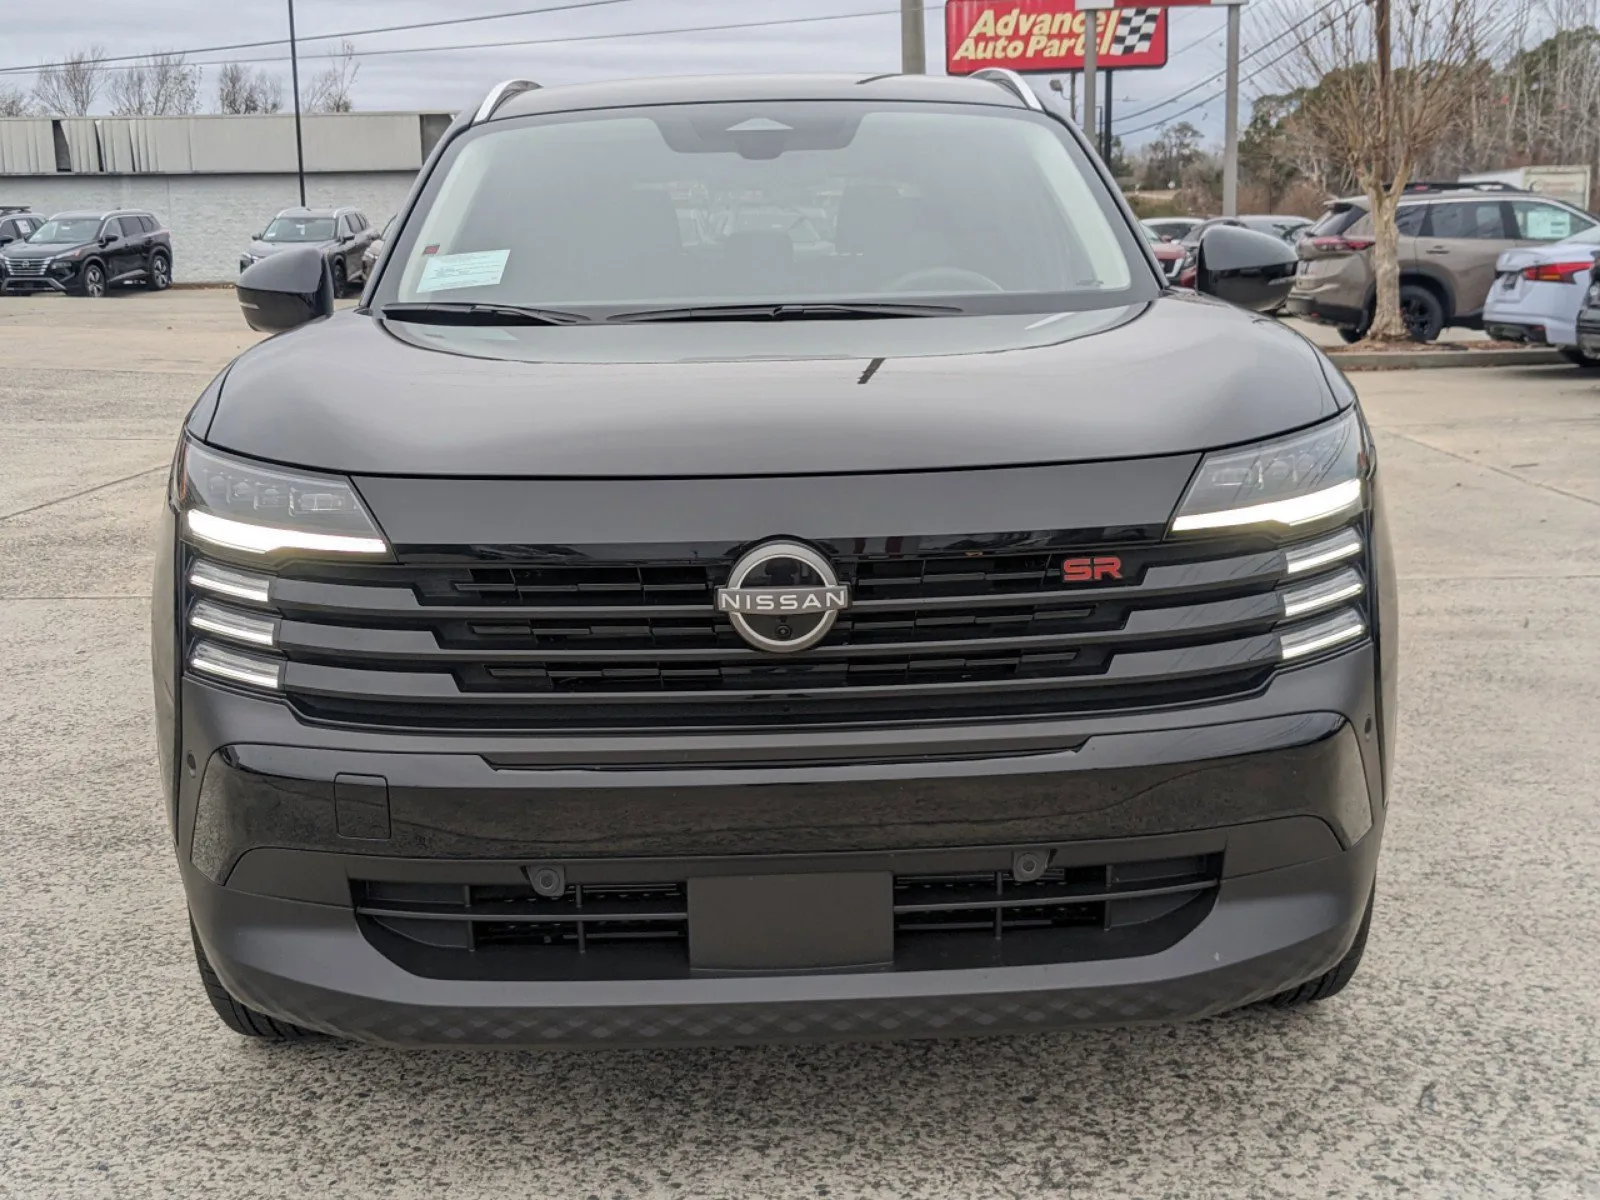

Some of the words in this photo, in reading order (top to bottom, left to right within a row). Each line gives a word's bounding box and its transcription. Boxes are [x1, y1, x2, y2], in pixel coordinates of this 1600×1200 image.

[952, 37, 1024, 61] Auto
[1064, 556, 1122, 580] SR
[721, 590, 845, 610] NISSAN
